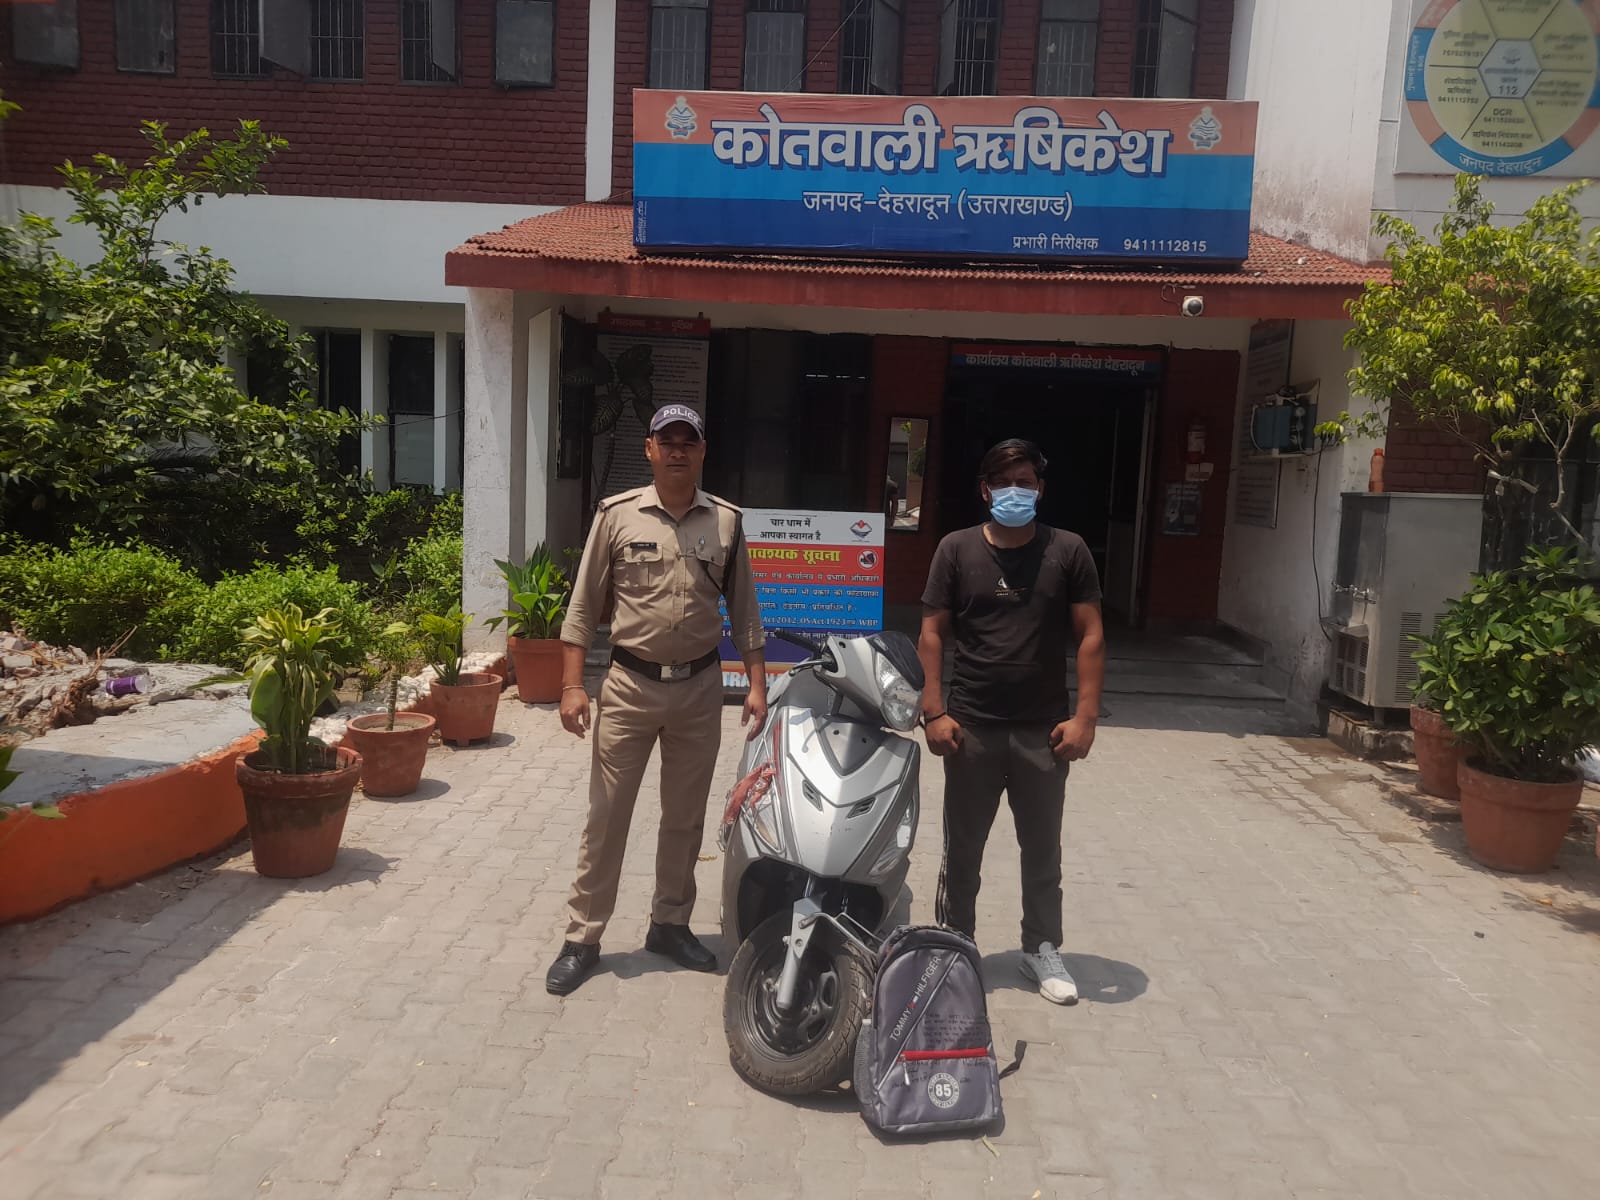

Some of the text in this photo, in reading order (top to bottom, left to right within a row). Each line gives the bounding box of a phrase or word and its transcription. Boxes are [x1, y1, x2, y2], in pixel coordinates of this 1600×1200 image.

[1498, 86, 1518, 96] 112
[711, 102, 1173, 178] कोतवाली ऋषिकेश
[1458, 152, 1544, 175] जनपद देहरादून
[957, 188, 1073, 222] (उत्तराखण्ड)
[1012, 232, 1099, 251] प्रभारी निरीक्षक
[1123, 238, 1208, 253] 9411112815
[965, 351, 1009, 366] कार्यालय
[1011, 353, 1057, 369] कोतवाली
[1104, 355, 1145, 376] देहरादून
[769, 518, 785, 527] चार
[804, 517, 812, 528] में
[760, 530, 822, 541] आपका स्वागत है
[802, 550, 841, 565] सूचना
[890, 956, 942, 1041] TOMMY HILFIGER
